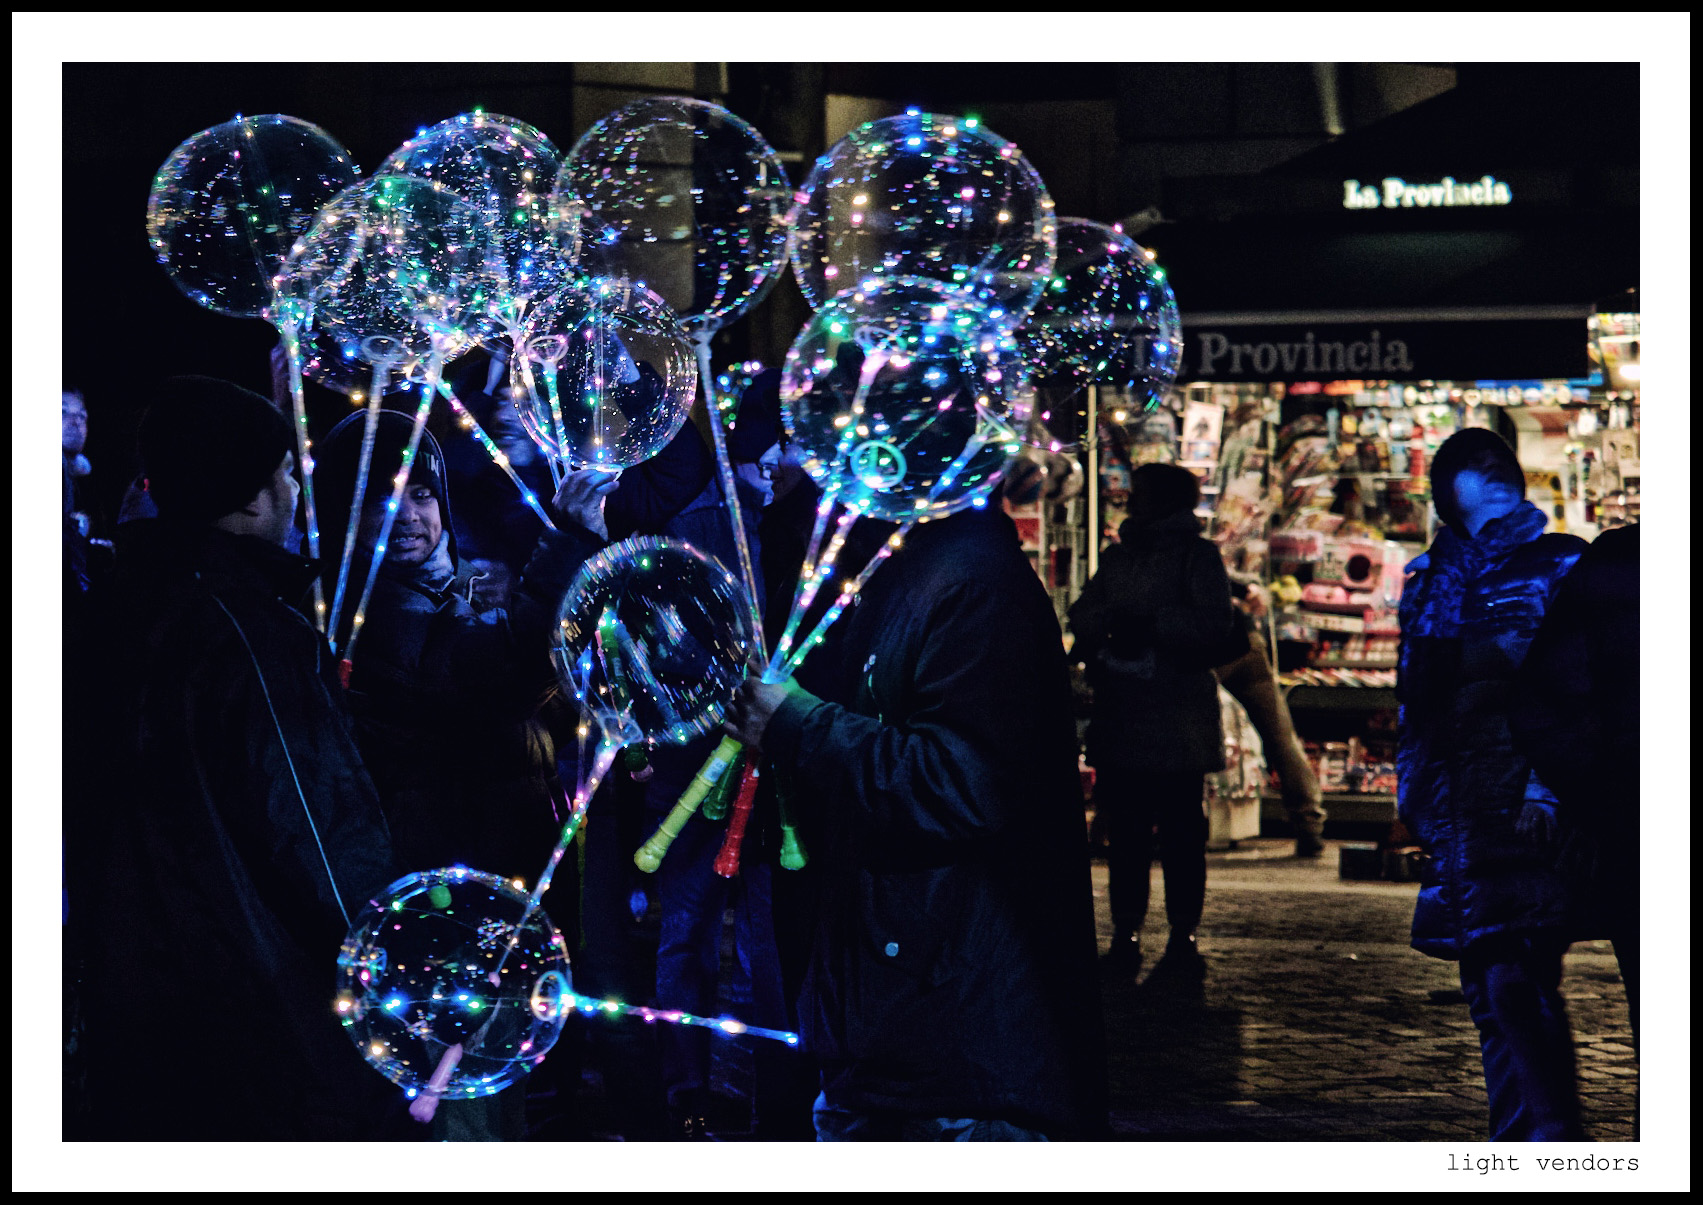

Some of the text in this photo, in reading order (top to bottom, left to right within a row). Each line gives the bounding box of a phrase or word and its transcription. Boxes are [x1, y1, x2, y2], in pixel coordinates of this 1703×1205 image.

[1342, 175, 1512, 209] La Provincia
[1198, 329, 1414, 375] Provincia
